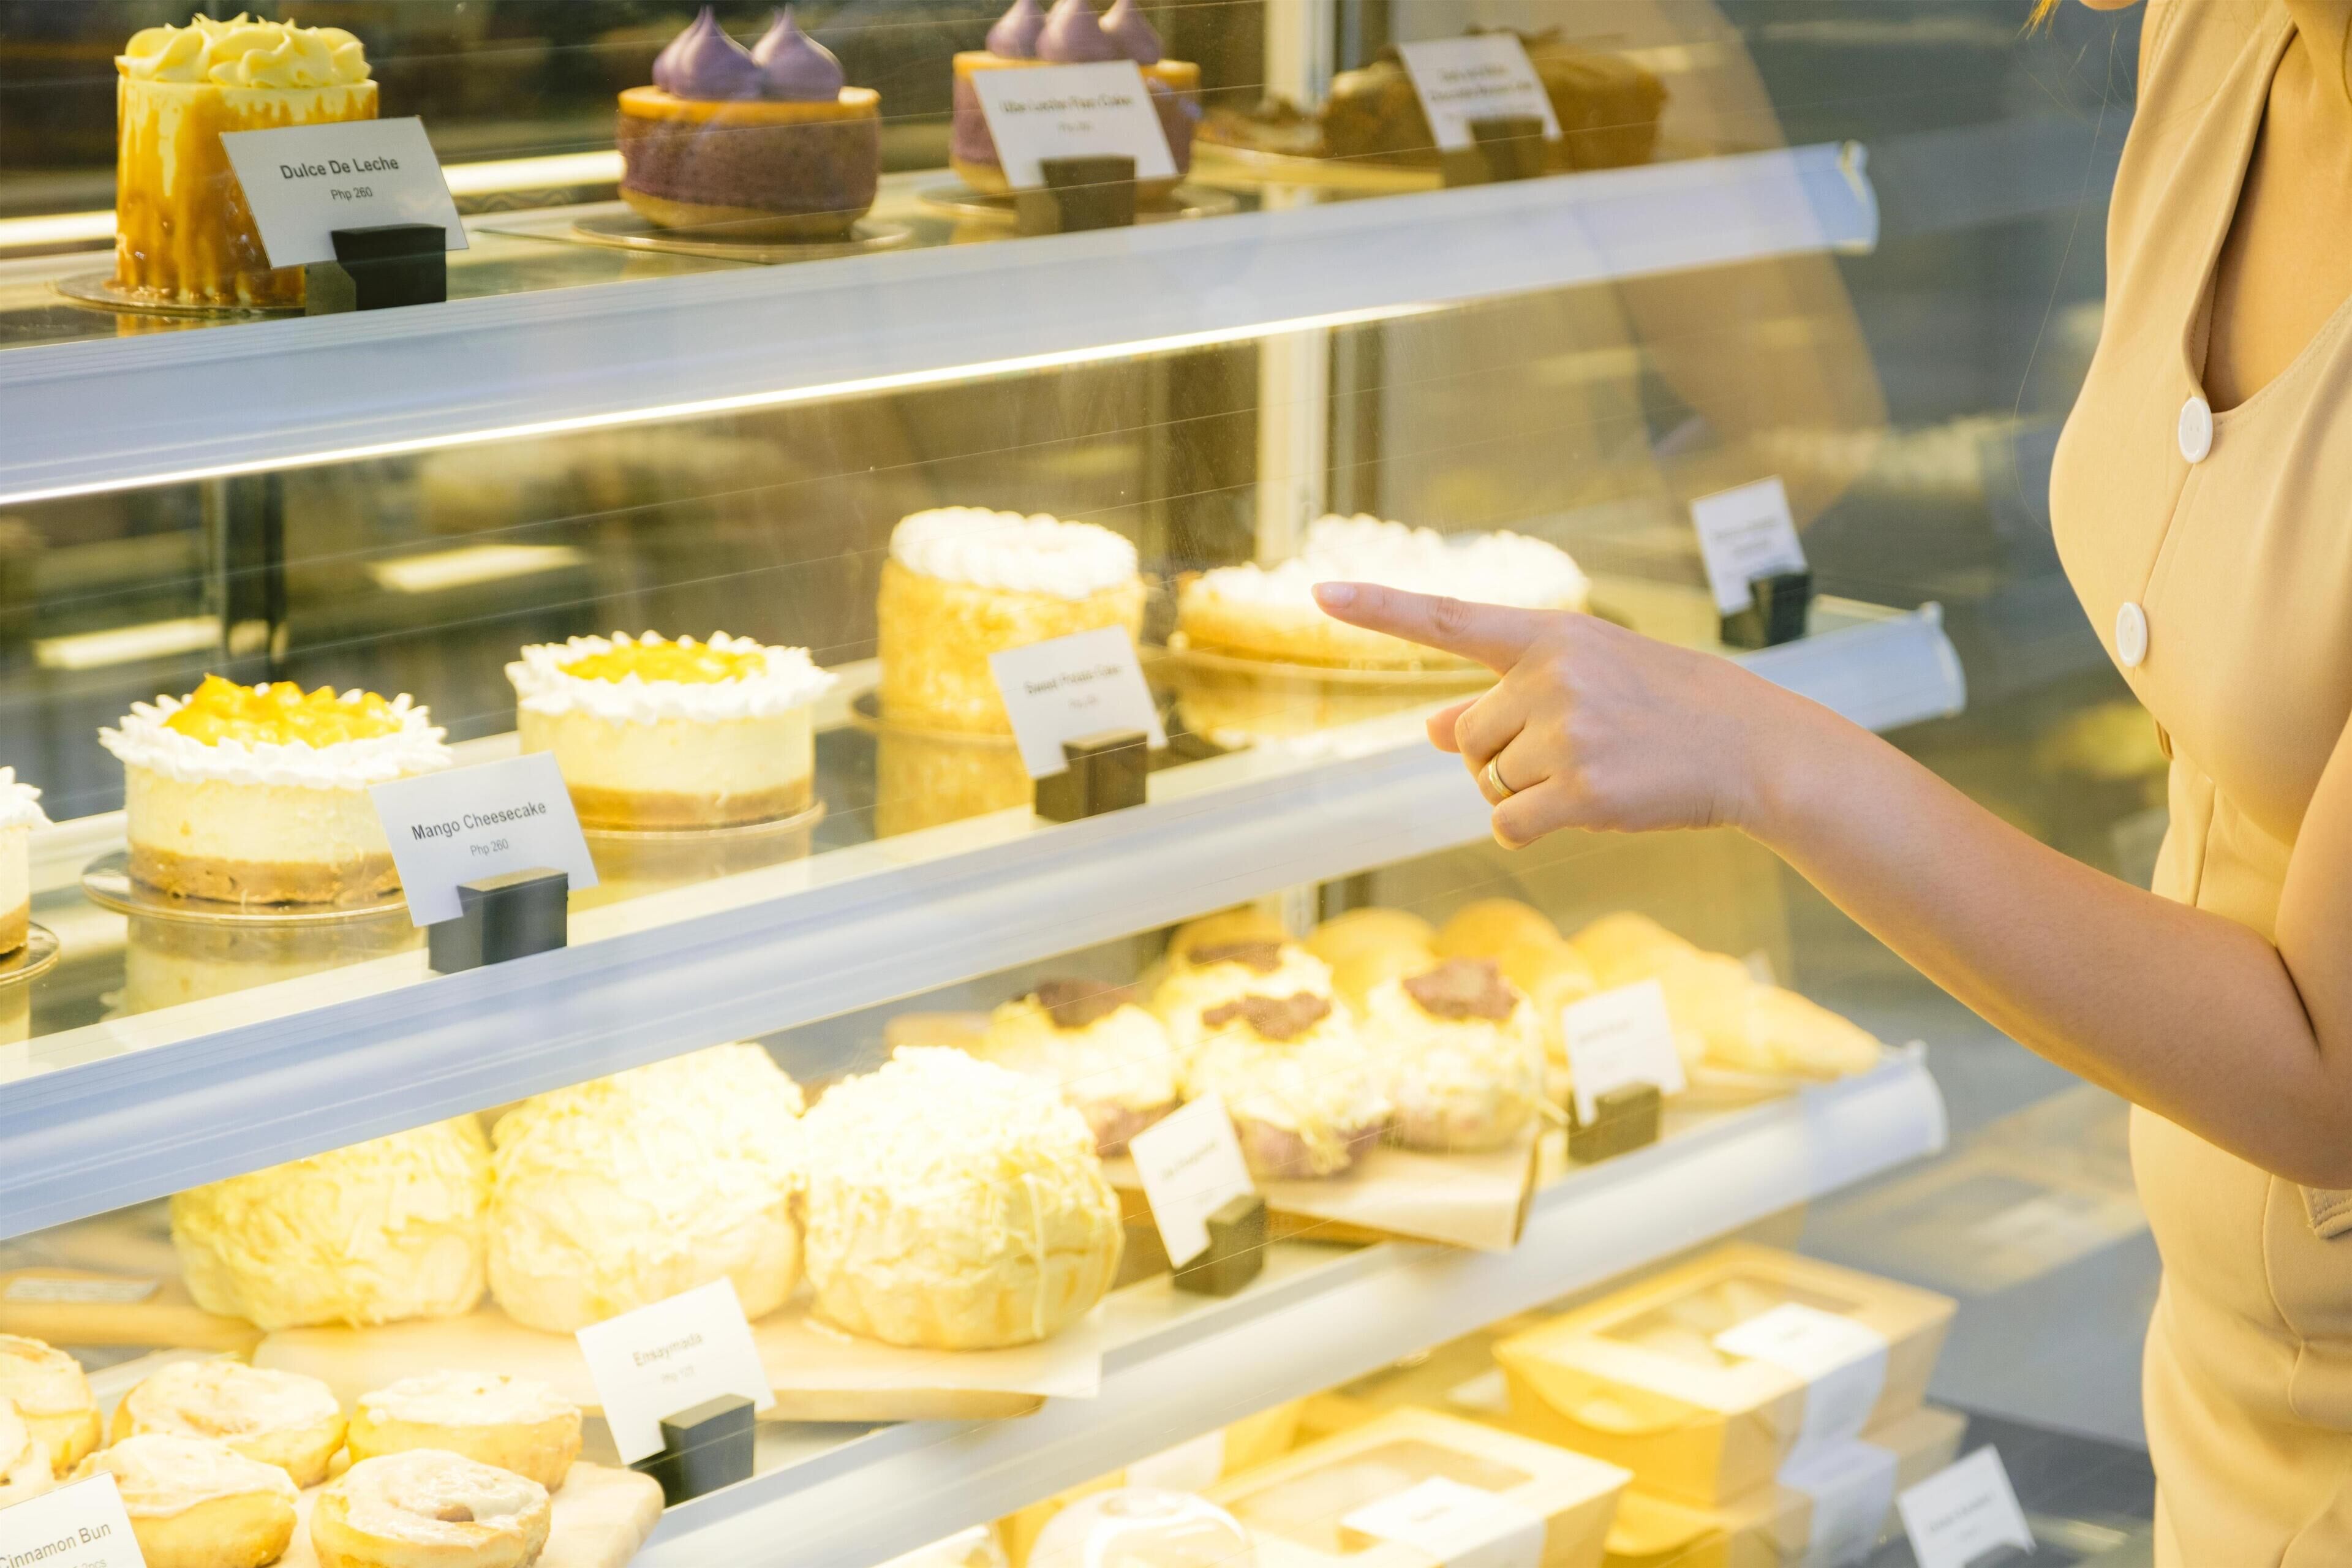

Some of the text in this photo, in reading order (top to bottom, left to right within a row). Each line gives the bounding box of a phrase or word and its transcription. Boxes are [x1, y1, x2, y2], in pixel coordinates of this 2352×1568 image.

[279, 156, 399, 179] Dulce De Leche
[330, 186, 373, 201] Php 260
[411, 802, 547, 841] Mango Cheesecake
[470, 839, 509, 856] Php 260
[632, 1333, 703, 1367] Ensaymada
[79, 1524, 111, 1544] Bun
